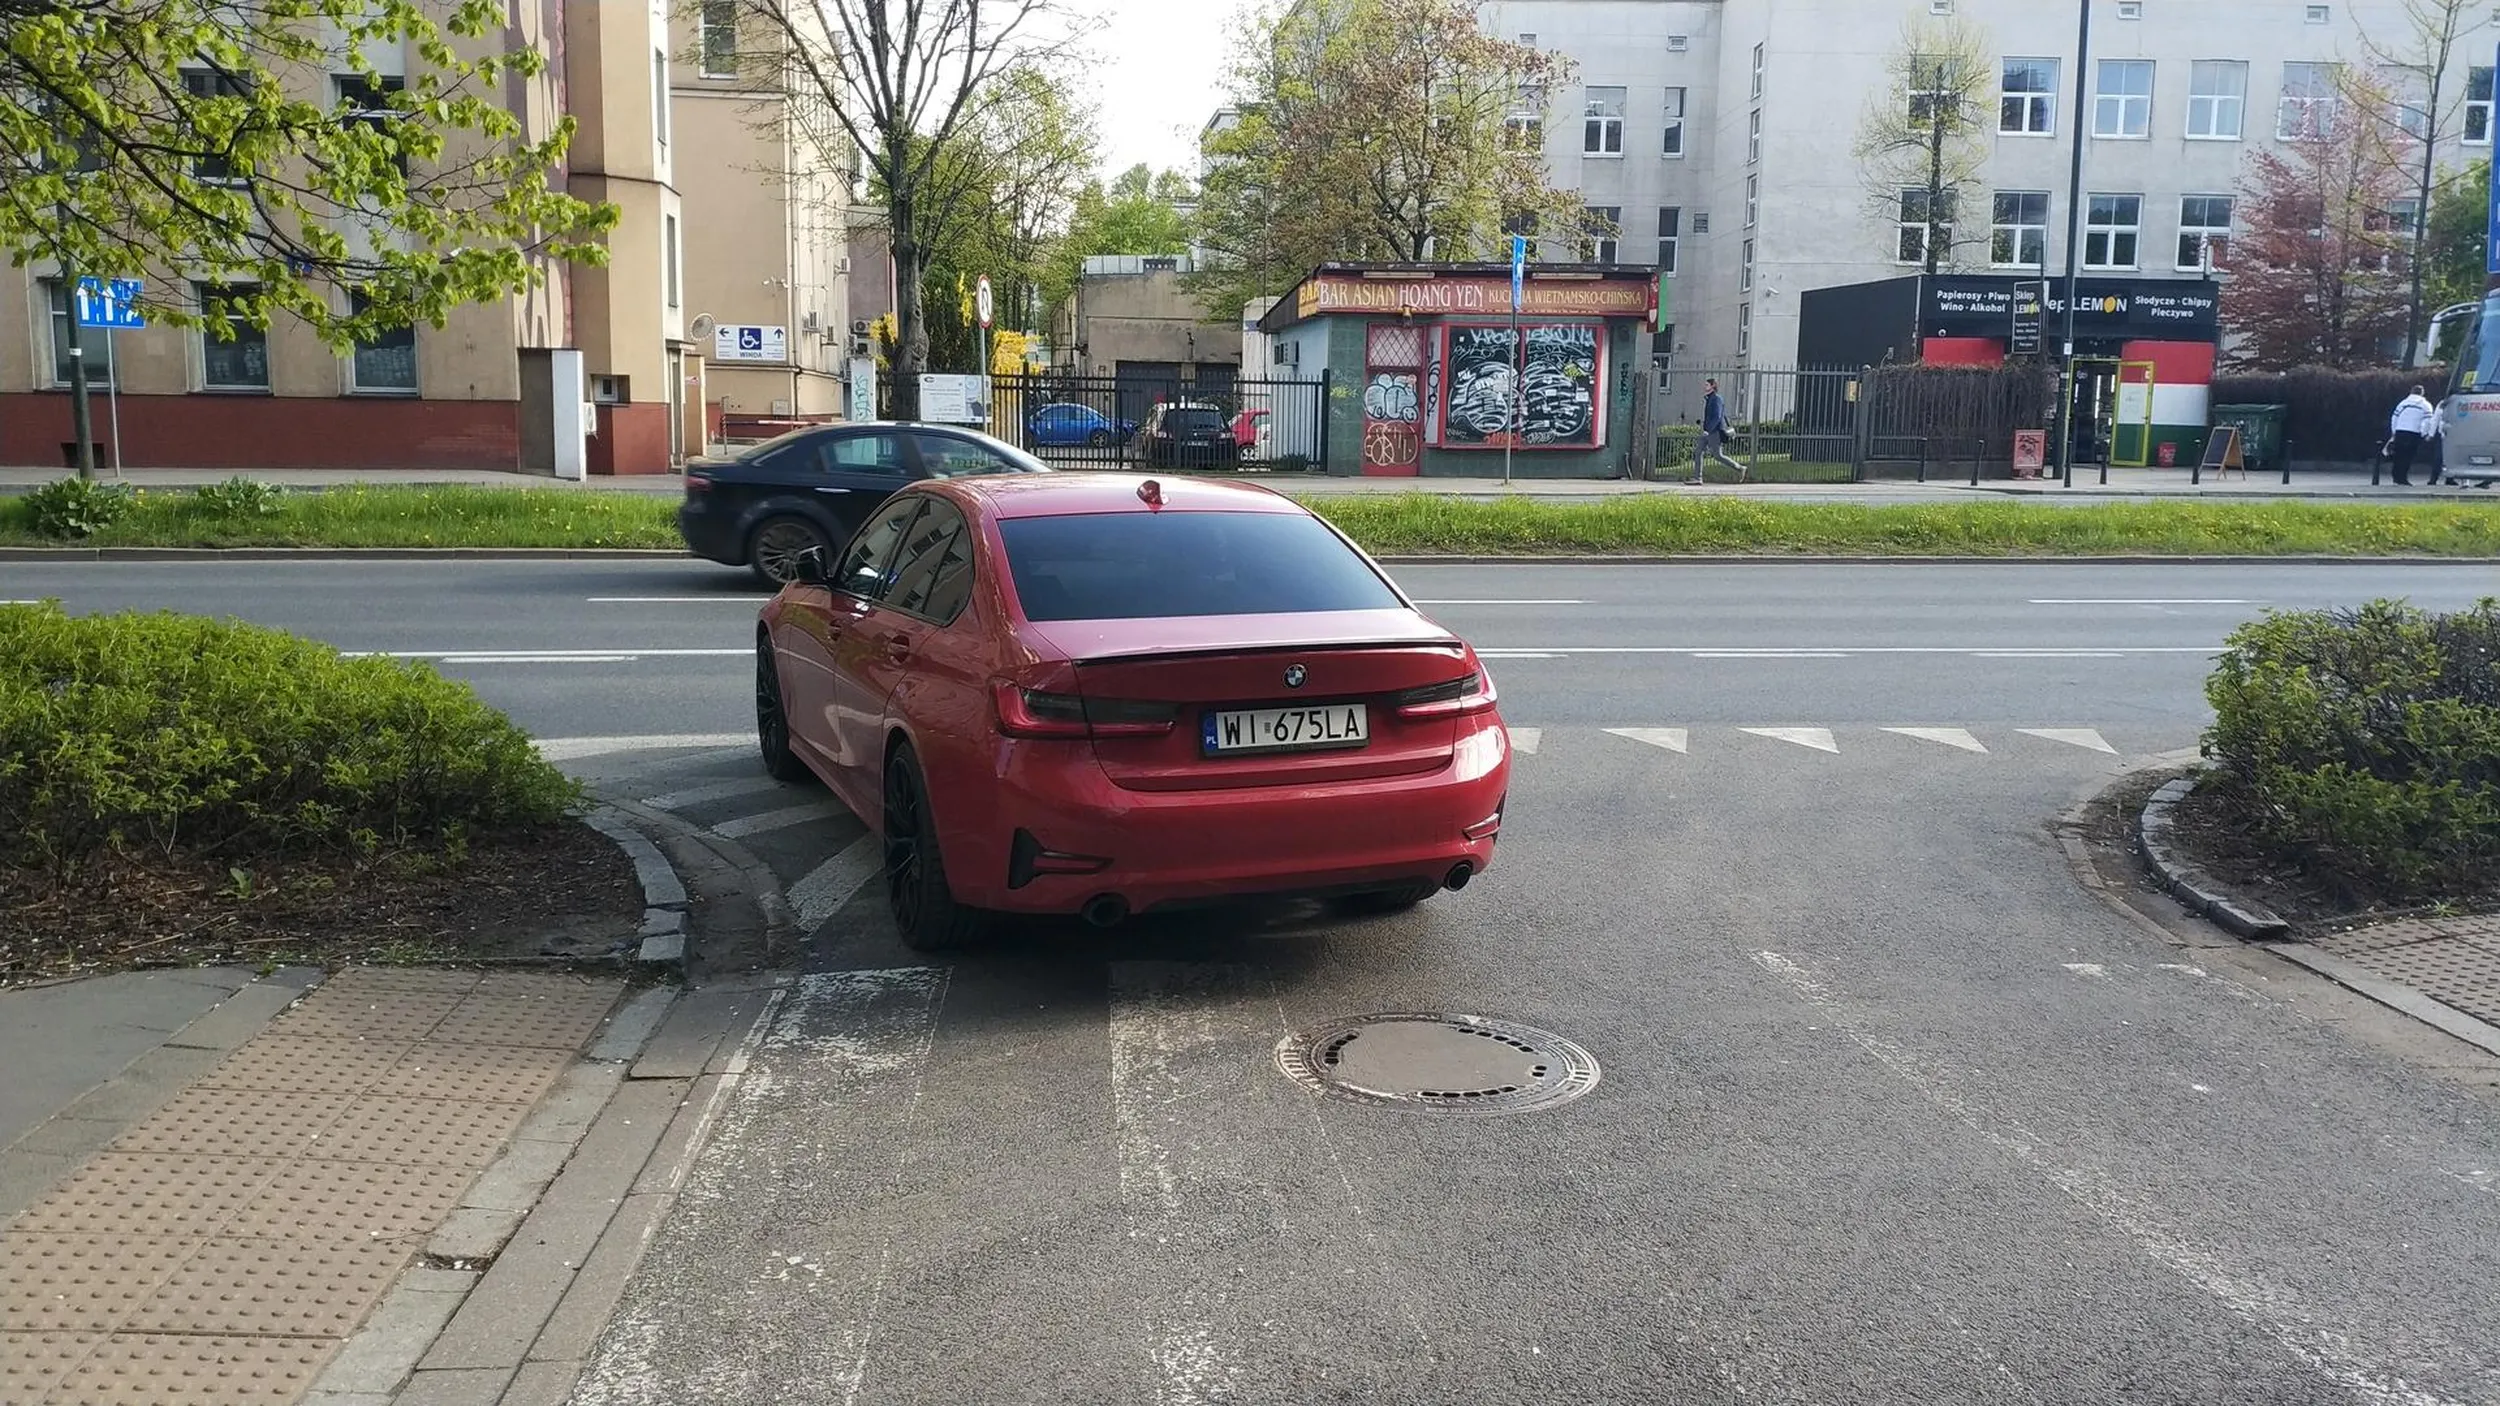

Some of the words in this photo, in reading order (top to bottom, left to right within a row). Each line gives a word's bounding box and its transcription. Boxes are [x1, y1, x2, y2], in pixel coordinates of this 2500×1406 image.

[1320, 283, 1349, 305] BAR
[1352, 284, 1396, 307] ASIAN
[1400, 283, 1450, 308] HOANG
[1455, 284, 1483, 308] YEN
[1534, 287, 1642, 305] WIETNAMSKO-CHIŃSKA
[1936, 290, 1981, 301] Papierosy
[1987, 291, 2011, 301] Piwo
[1940, 302, 1964, 312] Wino
[1969, 303, 2006, 313] Alkohol
[2015, 302, 2040, 314] LEMON
[2072, 296, 2127, 314] LEMON
[2182, 297, 2212, 309] Chipsy
[2151, 307, 2194, 319] Pieczywo
[1223, 714, 1257, 746] WI
[1273, 708, 1360, 743] 675LA
[1206, 736, 1217, 745] PL
